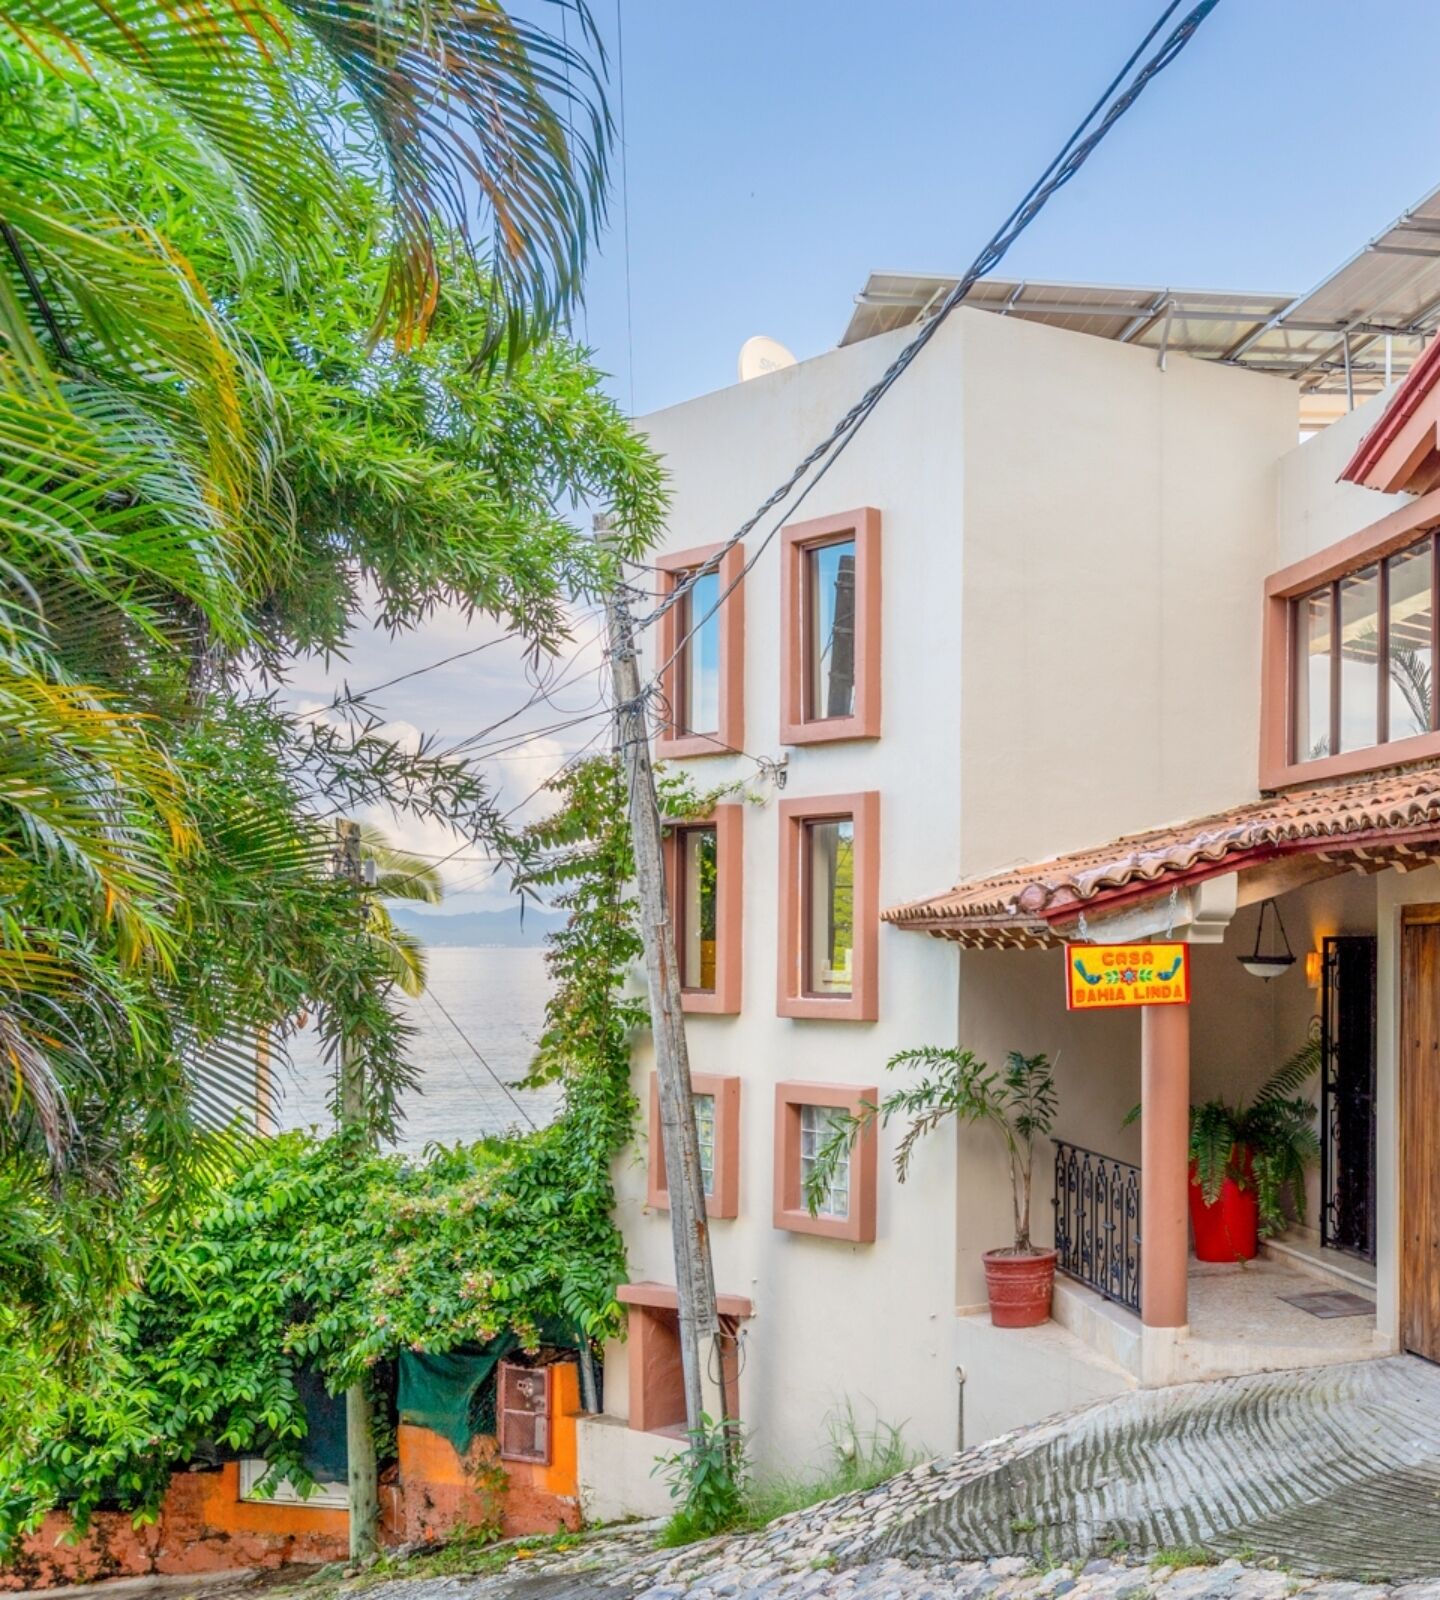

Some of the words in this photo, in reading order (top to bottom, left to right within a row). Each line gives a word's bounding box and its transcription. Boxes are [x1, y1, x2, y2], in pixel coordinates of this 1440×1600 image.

[1102, 951, 1154, 966] CASA
[1075, 988, 1126, 1003] BAHIA
[1133, 985, 1182, 1000] LINDA
